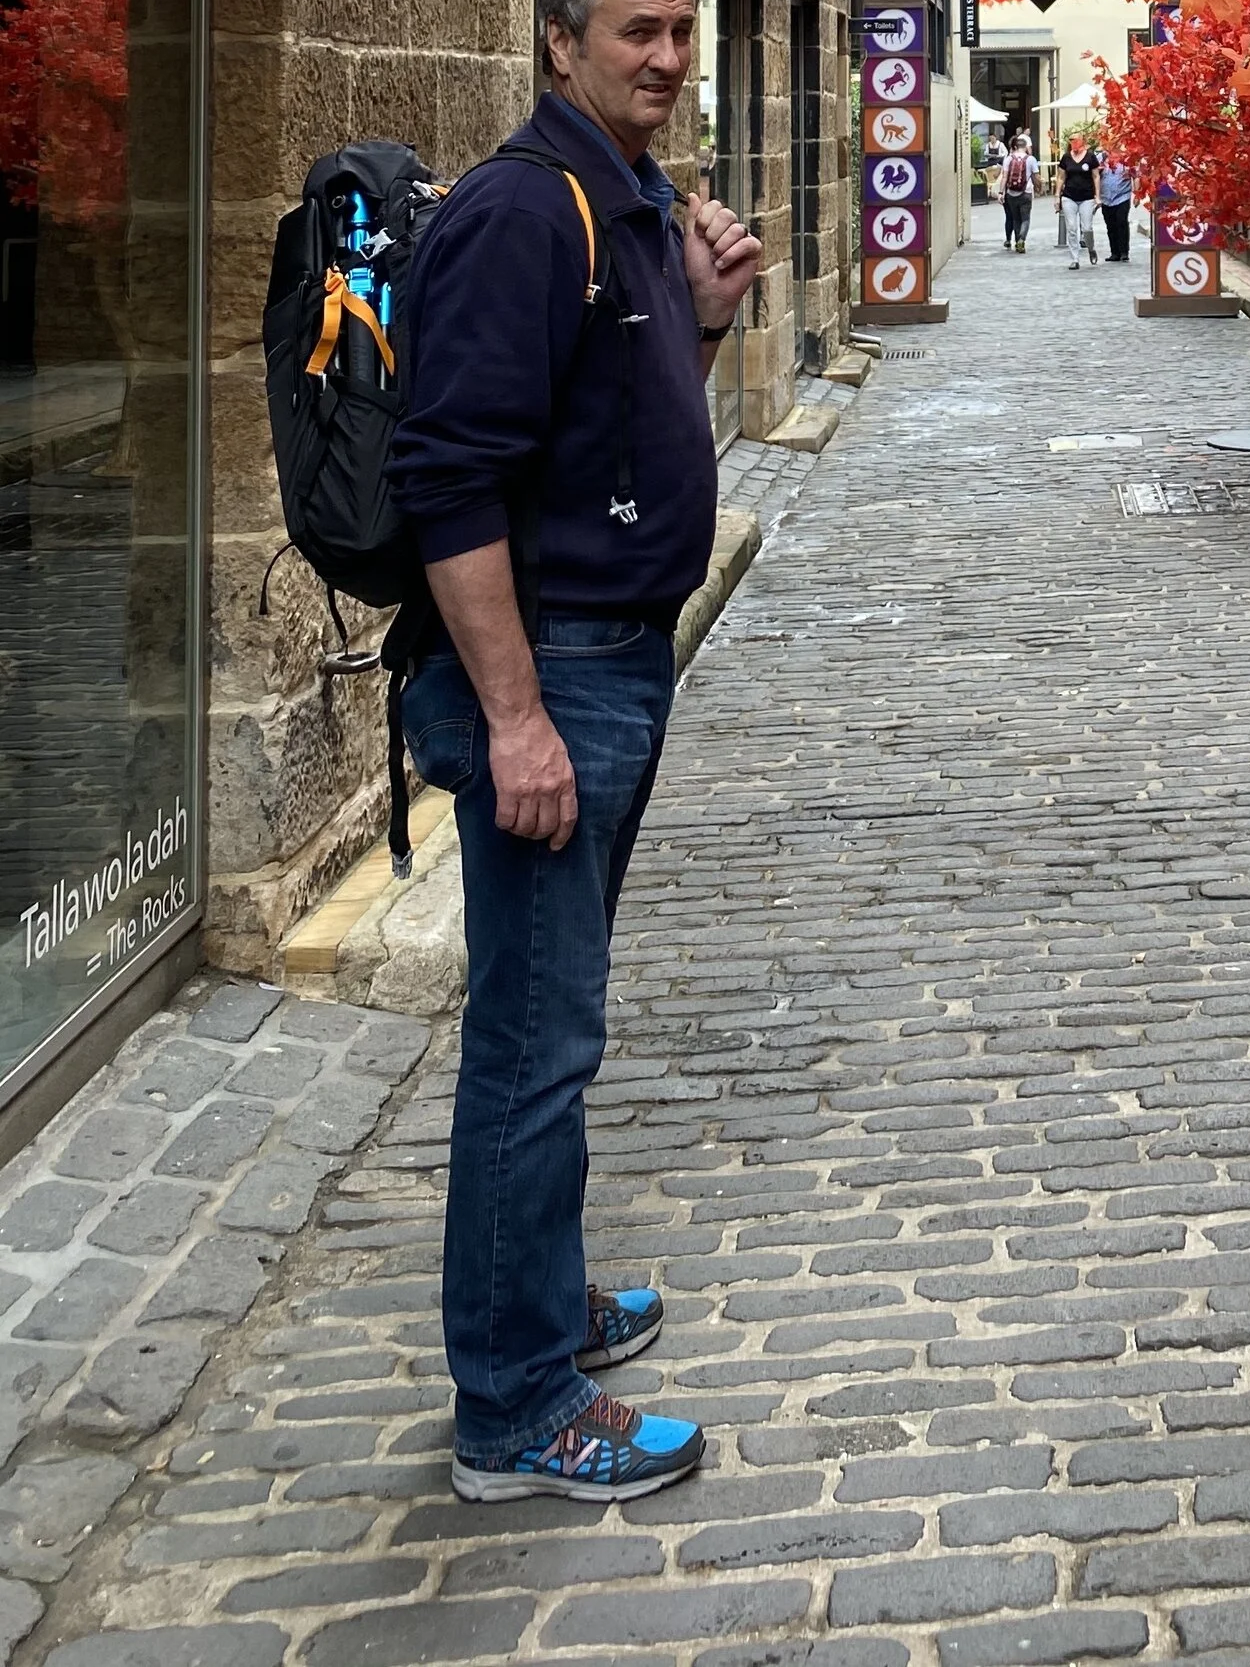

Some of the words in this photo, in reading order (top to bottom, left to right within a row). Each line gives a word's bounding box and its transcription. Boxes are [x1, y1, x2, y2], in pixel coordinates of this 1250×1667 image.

[873, 22, 896, 30] Toilets
[966, 6, 975, 41] TERRACE
[106, 917, 136, 965] The
[142, 875, 185, 938] Rocks
